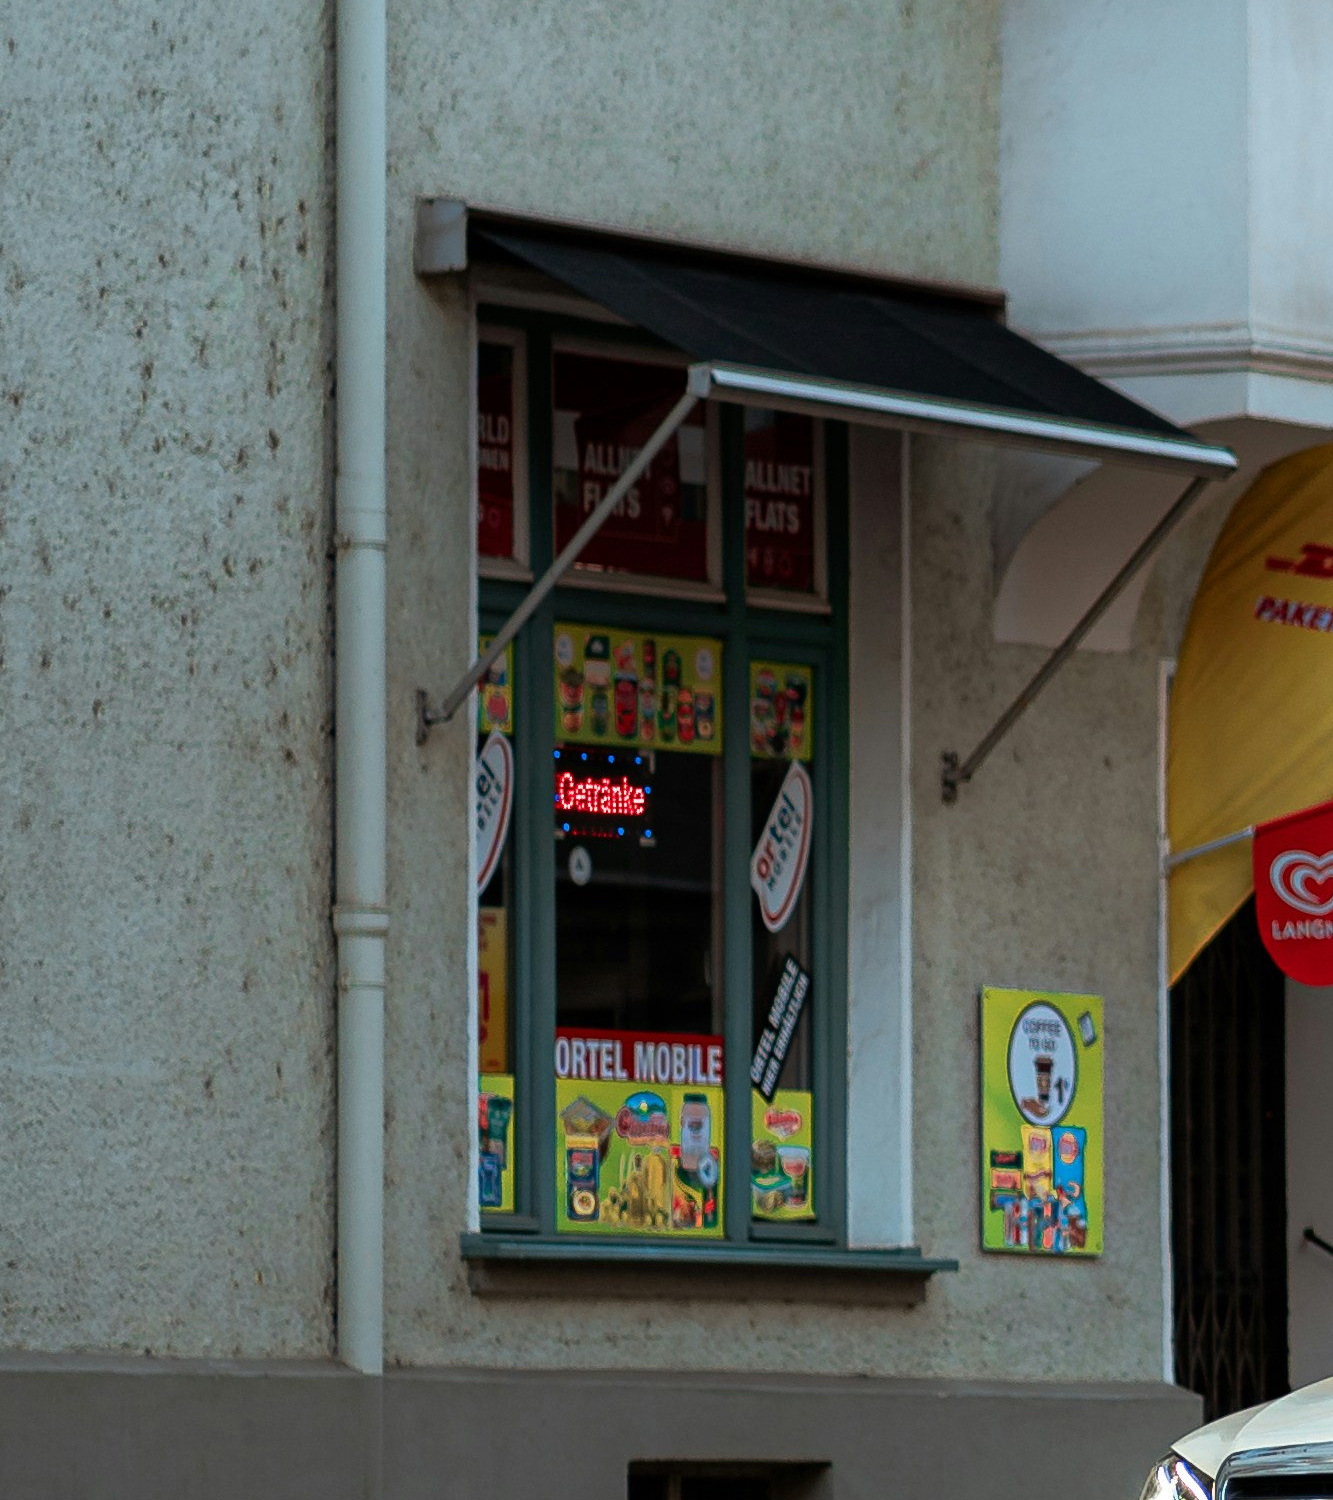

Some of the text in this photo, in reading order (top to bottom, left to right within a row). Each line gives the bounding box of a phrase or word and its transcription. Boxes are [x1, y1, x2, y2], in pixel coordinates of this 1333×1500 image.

[583, 441, 652, 482] ALLN
[745, 458, 812, 498] ALLNET
[745, 498, 800, 536] FLATS
[558, 771, 646, 817] Getränke
[755, 791, 797, 883] ortel
[555, 1036, 723, 1086] ORTEL MOBILE
